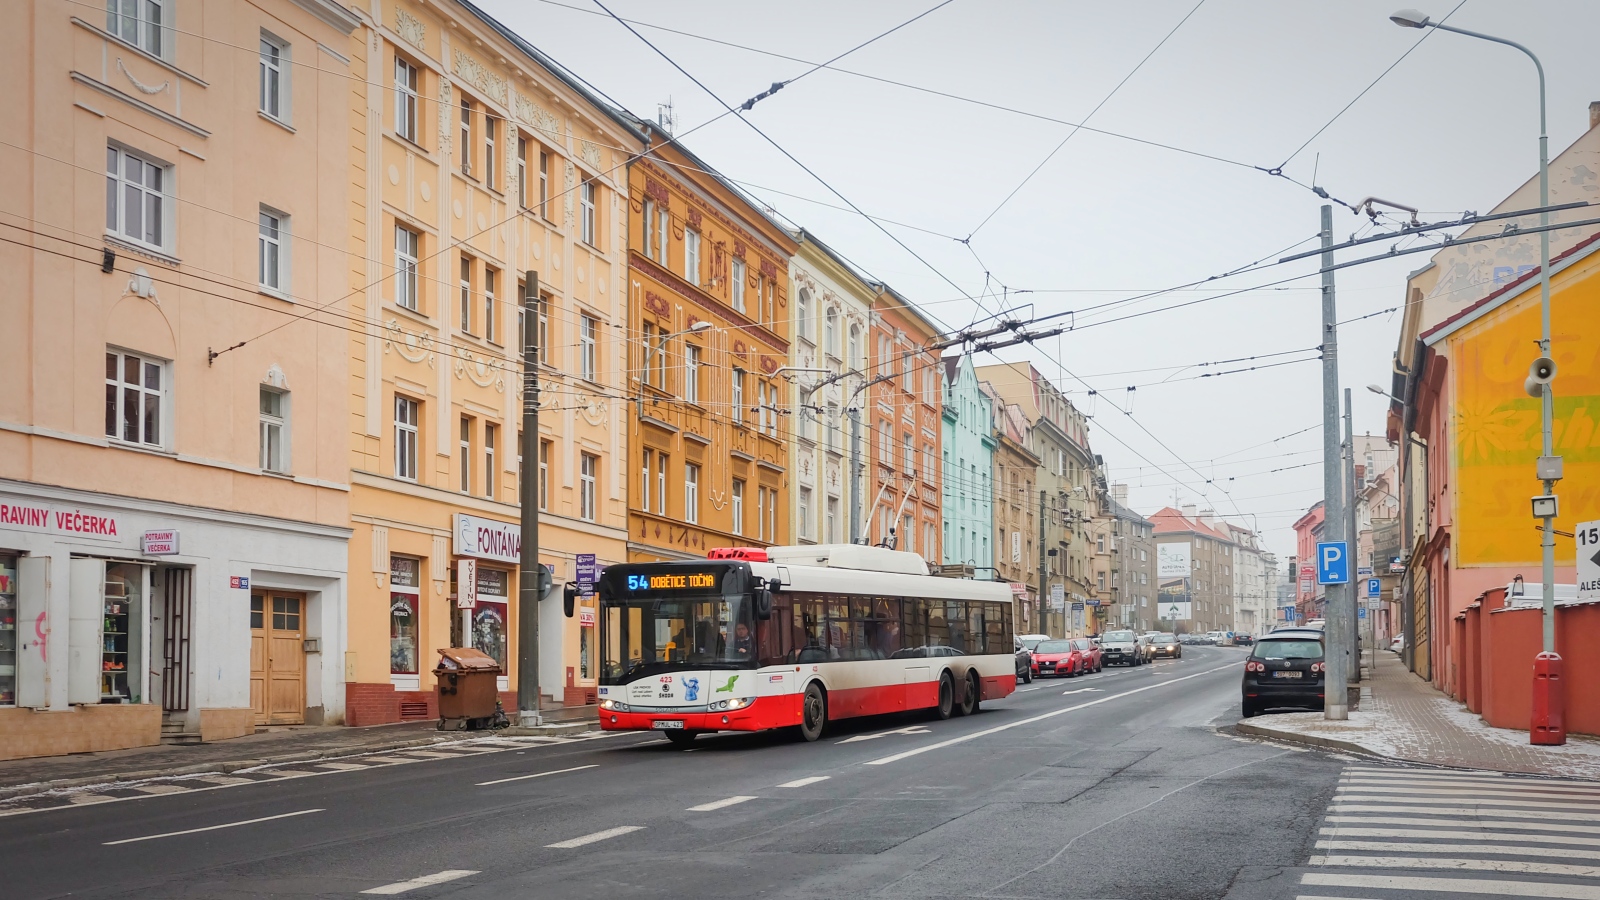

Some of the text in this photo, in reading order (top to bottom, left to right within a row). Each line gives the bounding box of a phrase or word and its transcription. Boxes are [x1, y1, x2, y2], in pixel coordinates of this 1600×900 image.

[0, 504, 117, 536] RAVINY VEČERKA
[145, 532, 173, 541] POTRAVINY
[478, 526, 522, 558] FONTÁNA
[1579, 528, 1600, 546] 15
[147, 543, 171, 552] VEČERKA
[1323, 546, 1341, 570] P
[628, 573, 714, 590] 54 DOBĚTICE TOČNA
[1370, 581, 1378, 592] P
